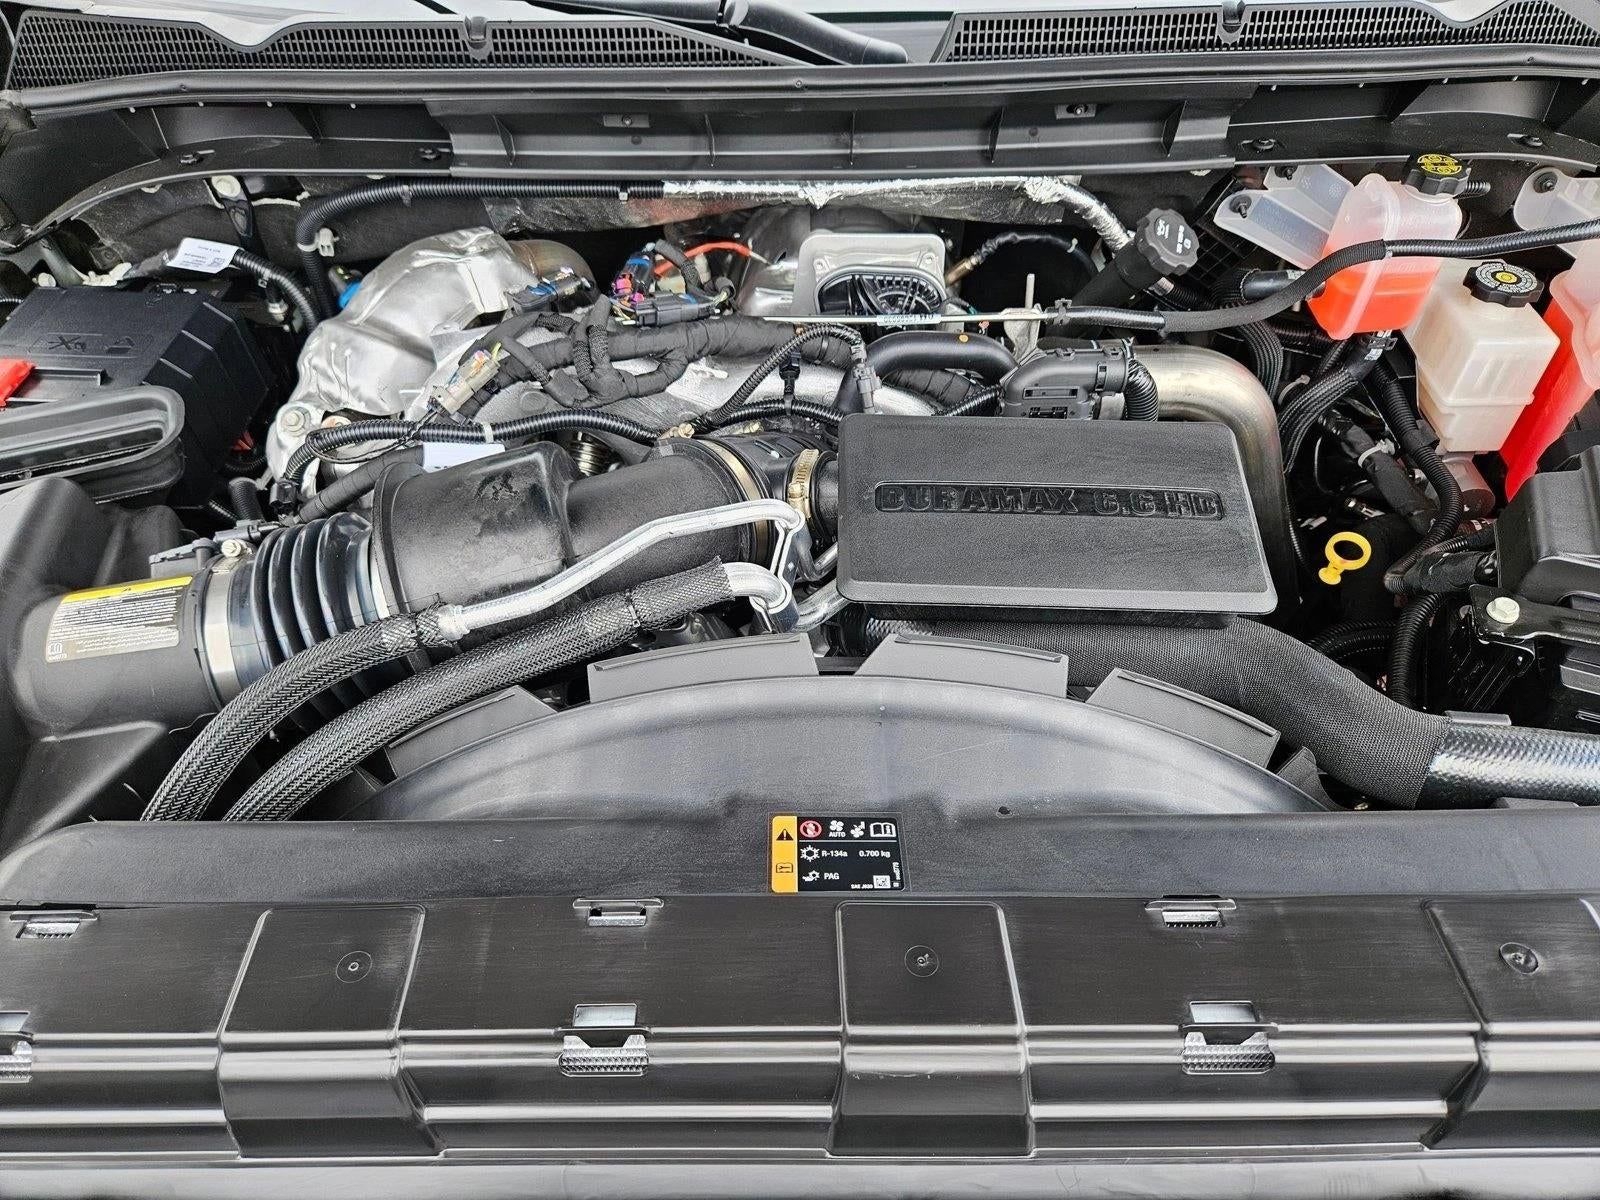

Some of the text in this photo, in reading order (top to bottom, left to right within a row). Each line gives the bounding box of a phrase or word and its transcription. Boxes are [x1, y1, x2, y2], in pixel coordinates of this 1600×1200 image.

[881, 486, 1078, 513] DURAMAX
[1163, 492, 1221, 518] HD
[821, 850, 891, 858] R-134a 0.700 kg
[823, 872, 840, 880] PAG
